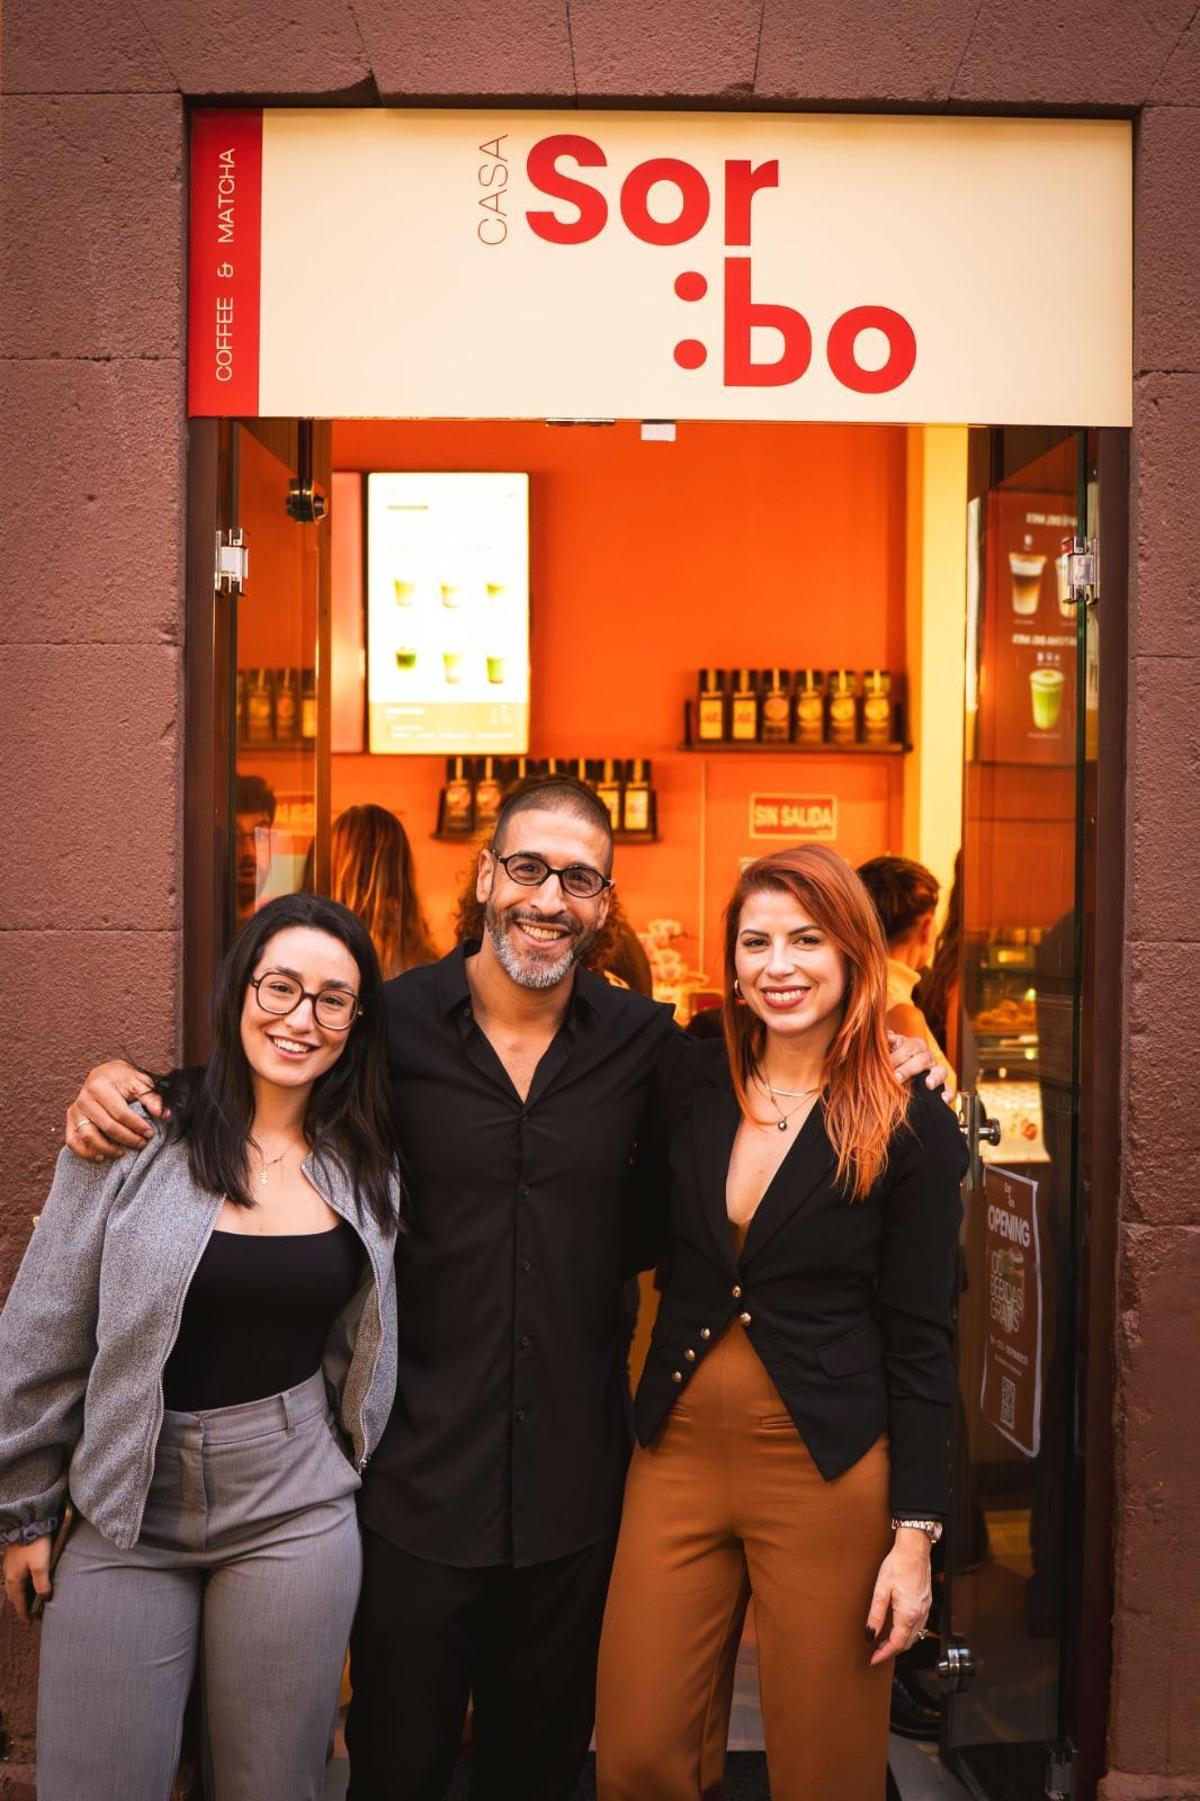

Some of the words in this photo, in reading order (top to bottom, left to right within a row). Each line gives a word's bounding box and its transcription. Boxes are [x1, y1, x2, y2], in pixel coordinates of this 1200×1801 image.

[218, 148, 235, 243] MATCHA
[478, 134, 509, 246] CASA
[525, 134, 779, 246] Sor
[217, 262, 234, 278] &
[215, 298, 233, 382] COFFEE
[755, 806, 778, 826] SIN
[781, 806, 832, 828] SALIDA
[988, 1205, 1031, 1248] OPENING
